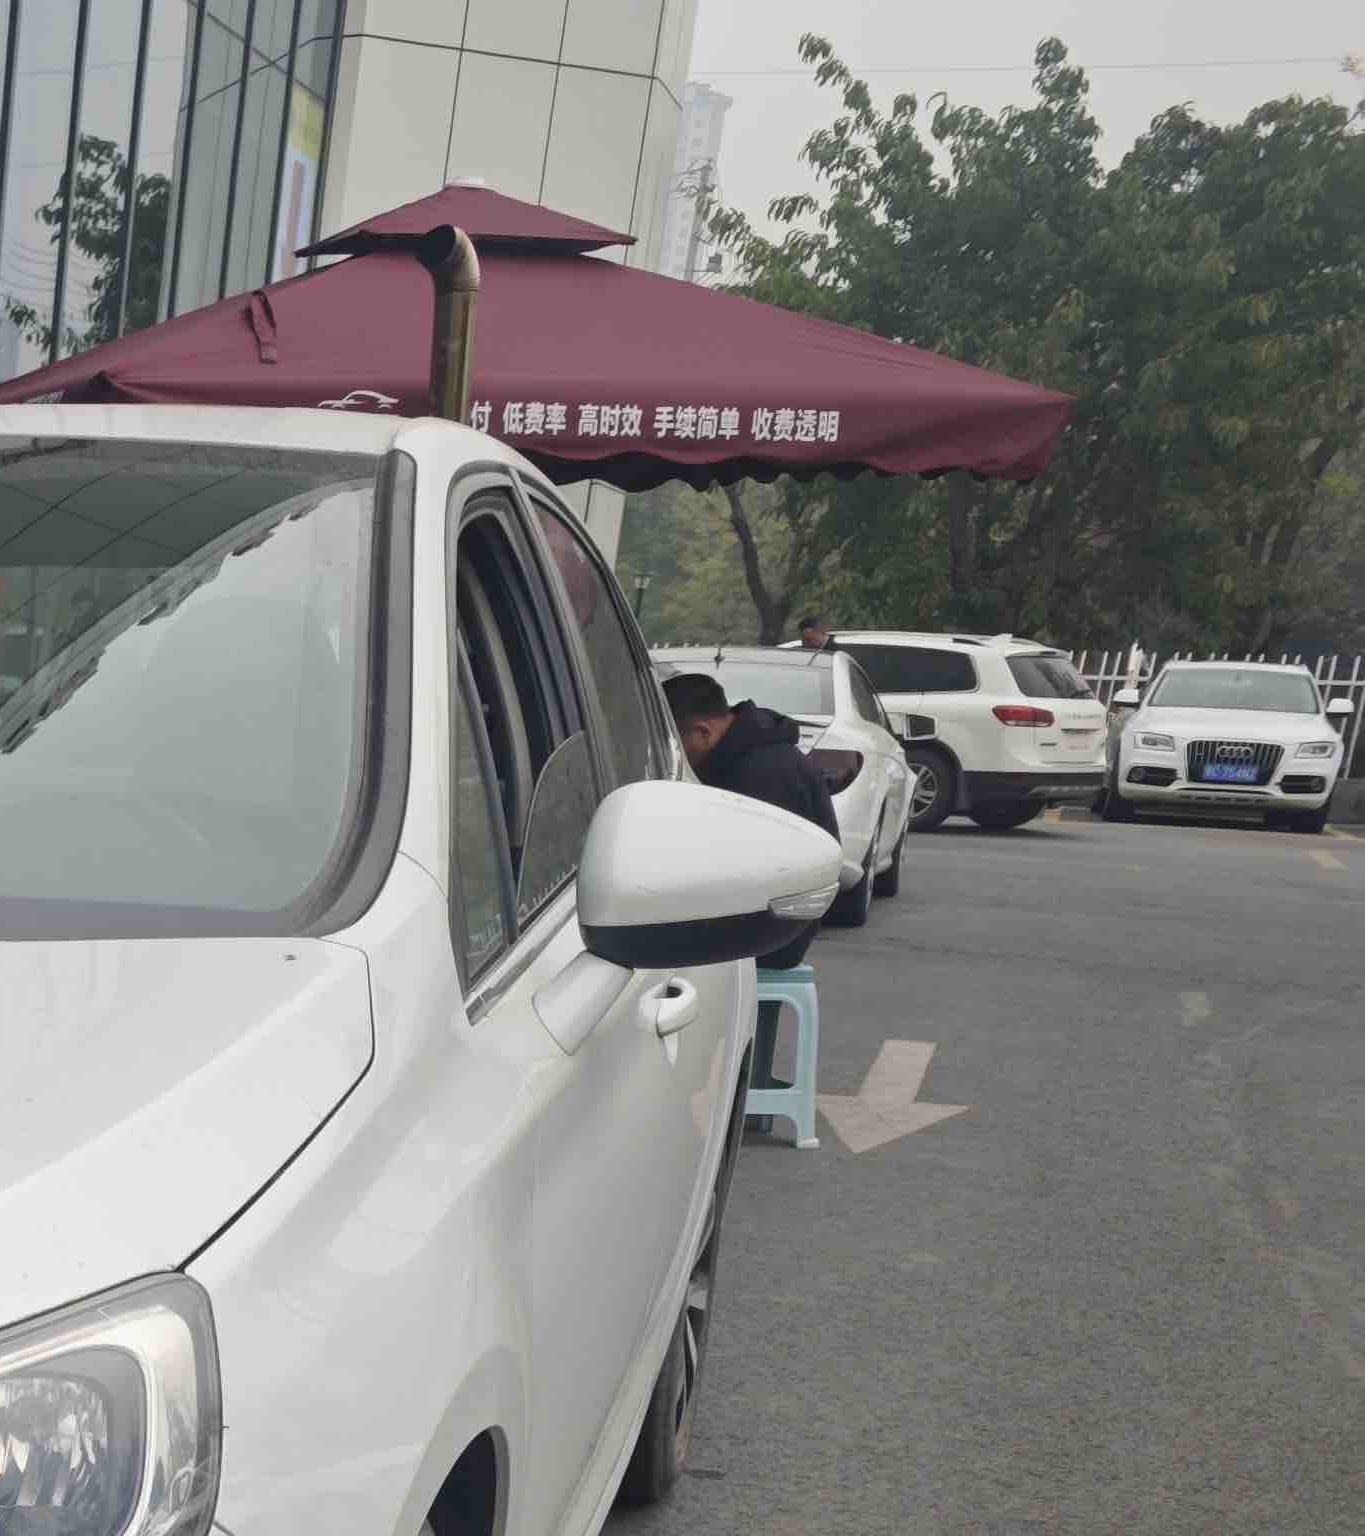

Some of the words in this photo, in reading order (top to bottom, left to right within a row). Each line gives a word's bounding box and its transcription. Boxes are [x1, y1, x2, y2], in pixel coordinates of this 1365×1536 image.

[502, 402, 567, 436] 低费率
[577, 403, 643, 437] 高时效
[653, 405, 741, 440] 手续简单
[750, 407, 840, 442] 收费透明
